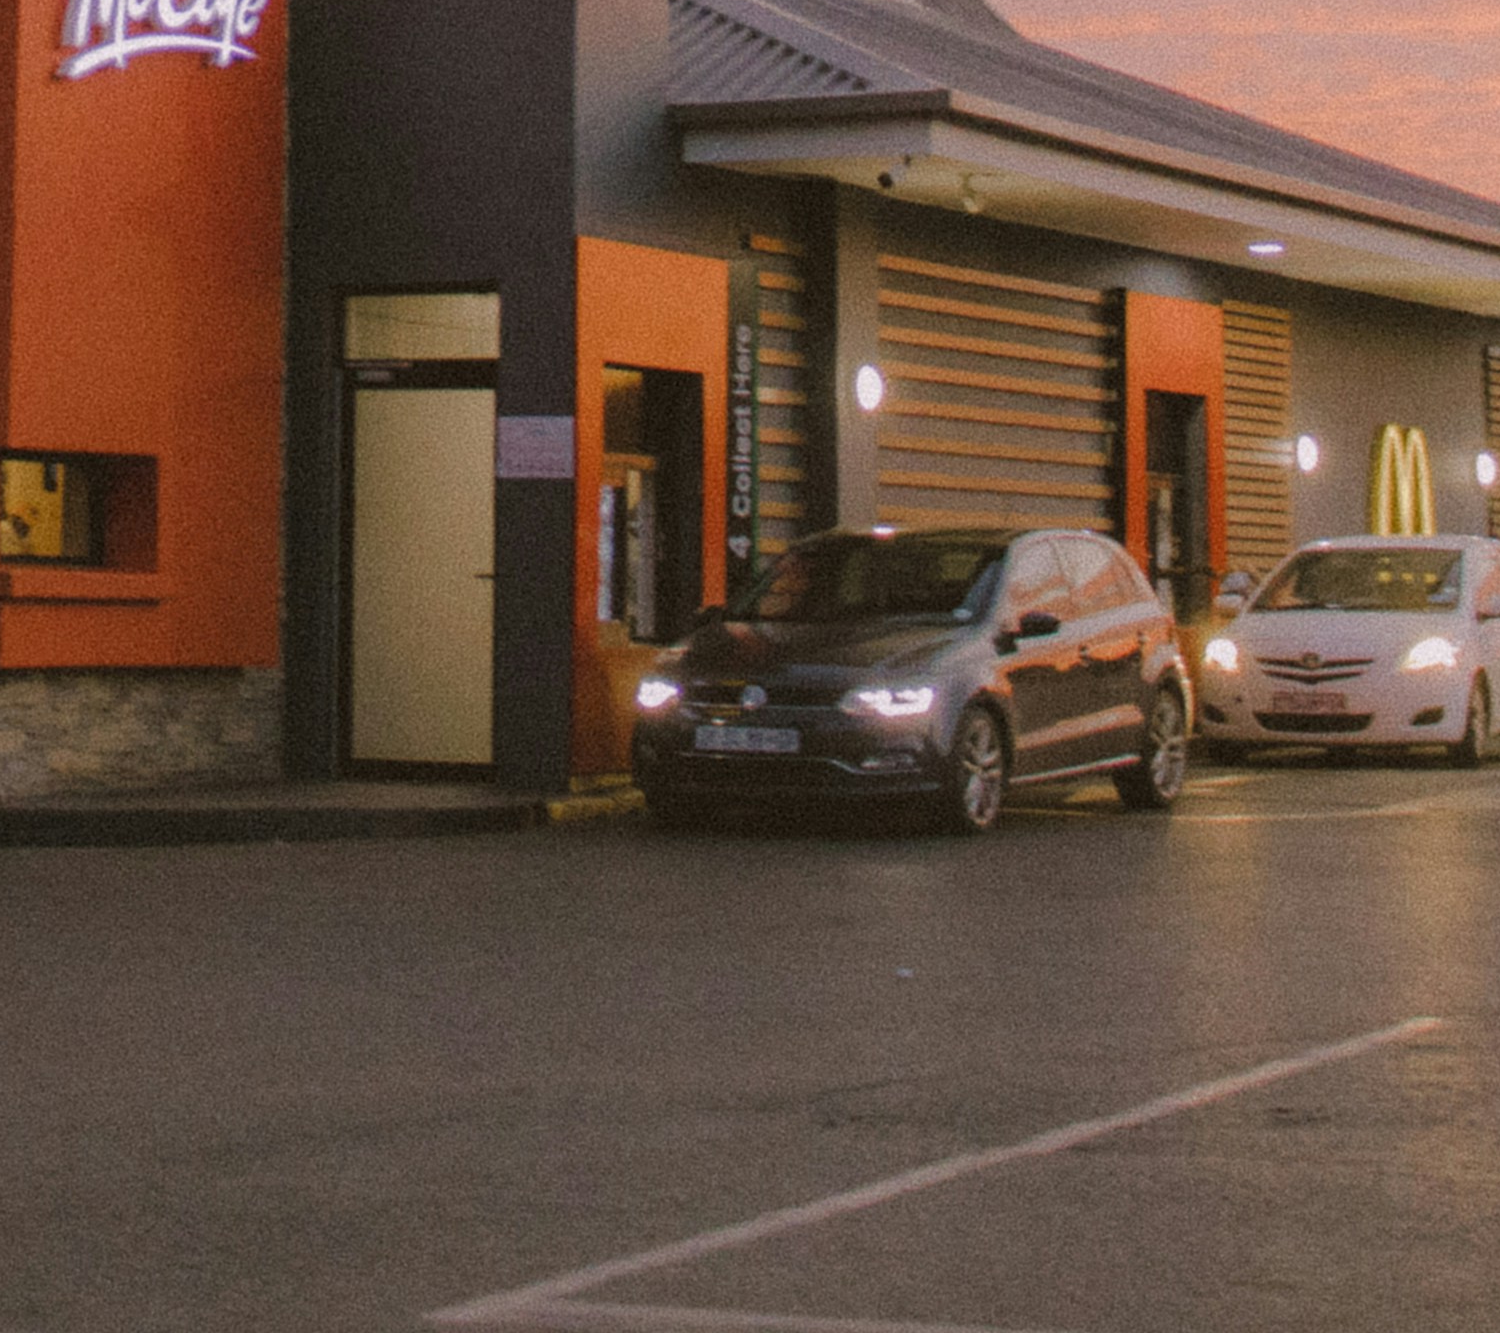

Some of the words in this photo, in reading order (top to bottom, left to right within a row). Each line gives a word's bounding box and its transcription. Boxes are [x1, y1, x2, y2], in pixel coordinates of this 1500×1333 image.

[730, 322, 752, 398] Here
[730, 404, 752, 519] Collect
[727, 533, 751, 560] 4
